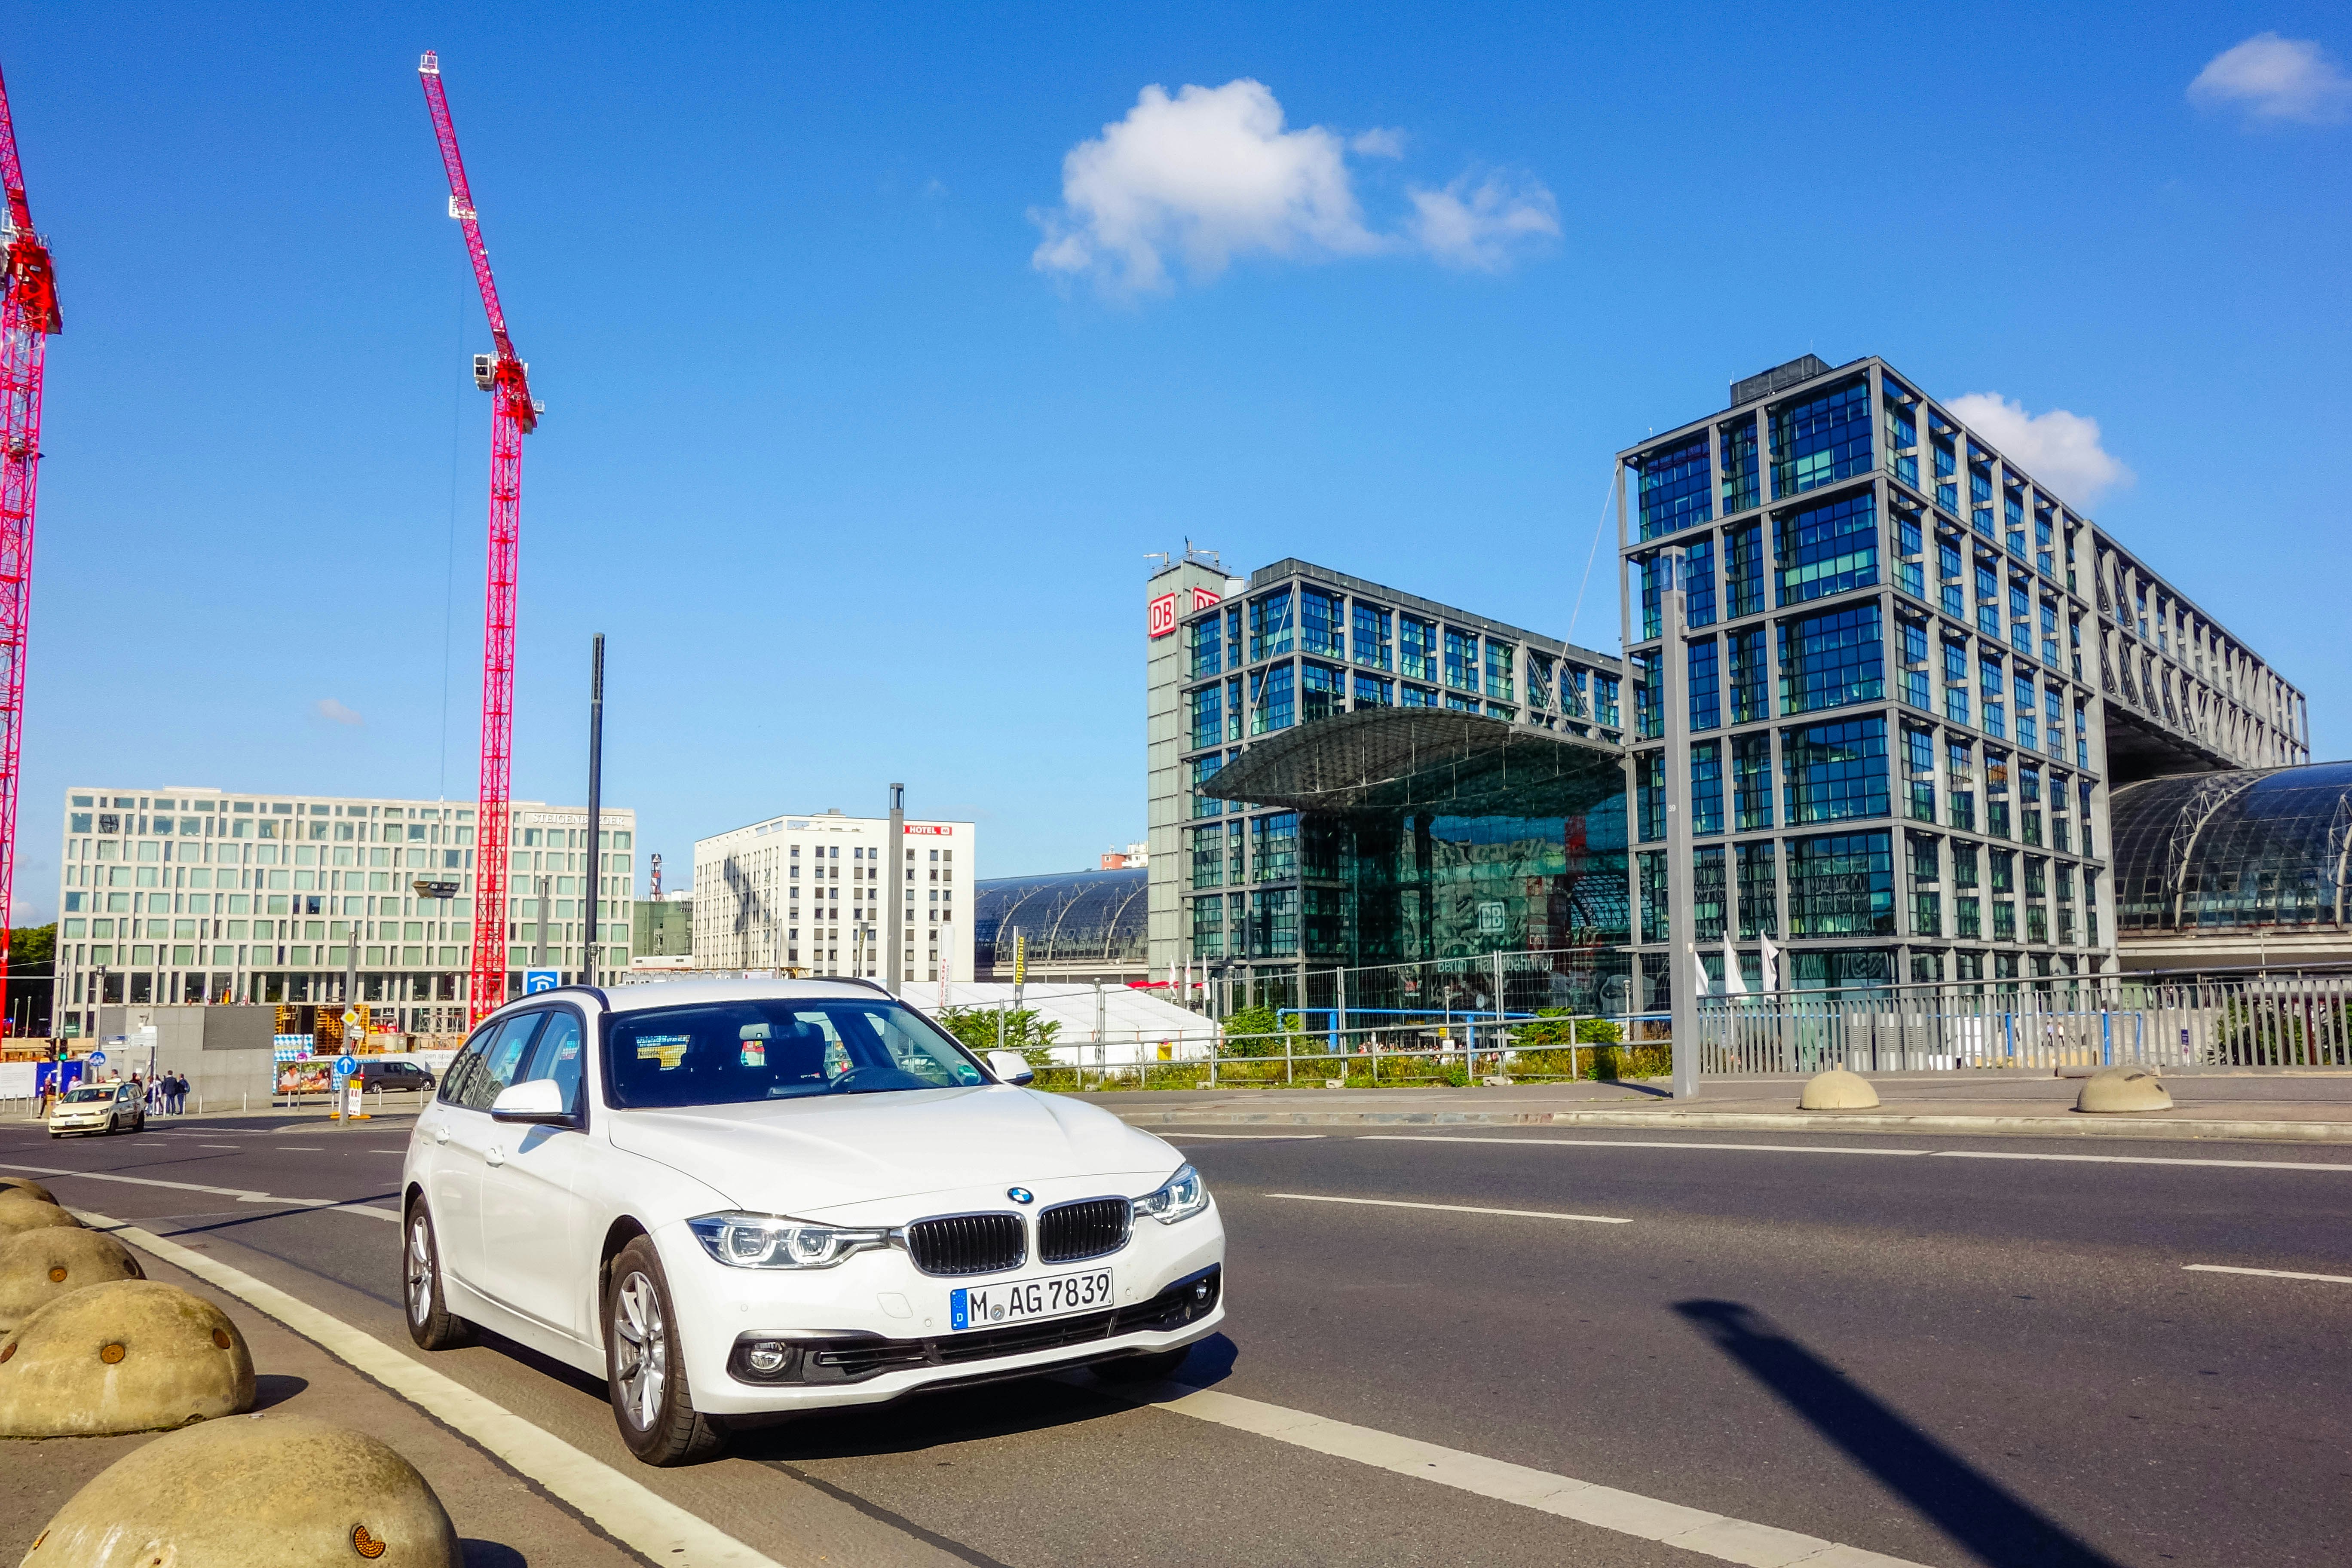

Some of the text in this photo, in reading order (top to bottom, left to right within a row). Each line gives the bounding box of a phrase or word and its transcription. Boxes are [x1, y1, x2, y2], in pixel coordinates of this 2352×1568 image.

[1153, 600, 1172, 631] DB
[533, 814, 625, 826] STEIGENBGER
[1481, 906, 1502, 928] DB
[1015, 936, 1026, 986] Implenia
[1437, 954, 1554, 973] Berlin Hautbahnhof
[970, 1274, 1110, 1322] M AG 7839
[957, 1313, 963, 1322] D
